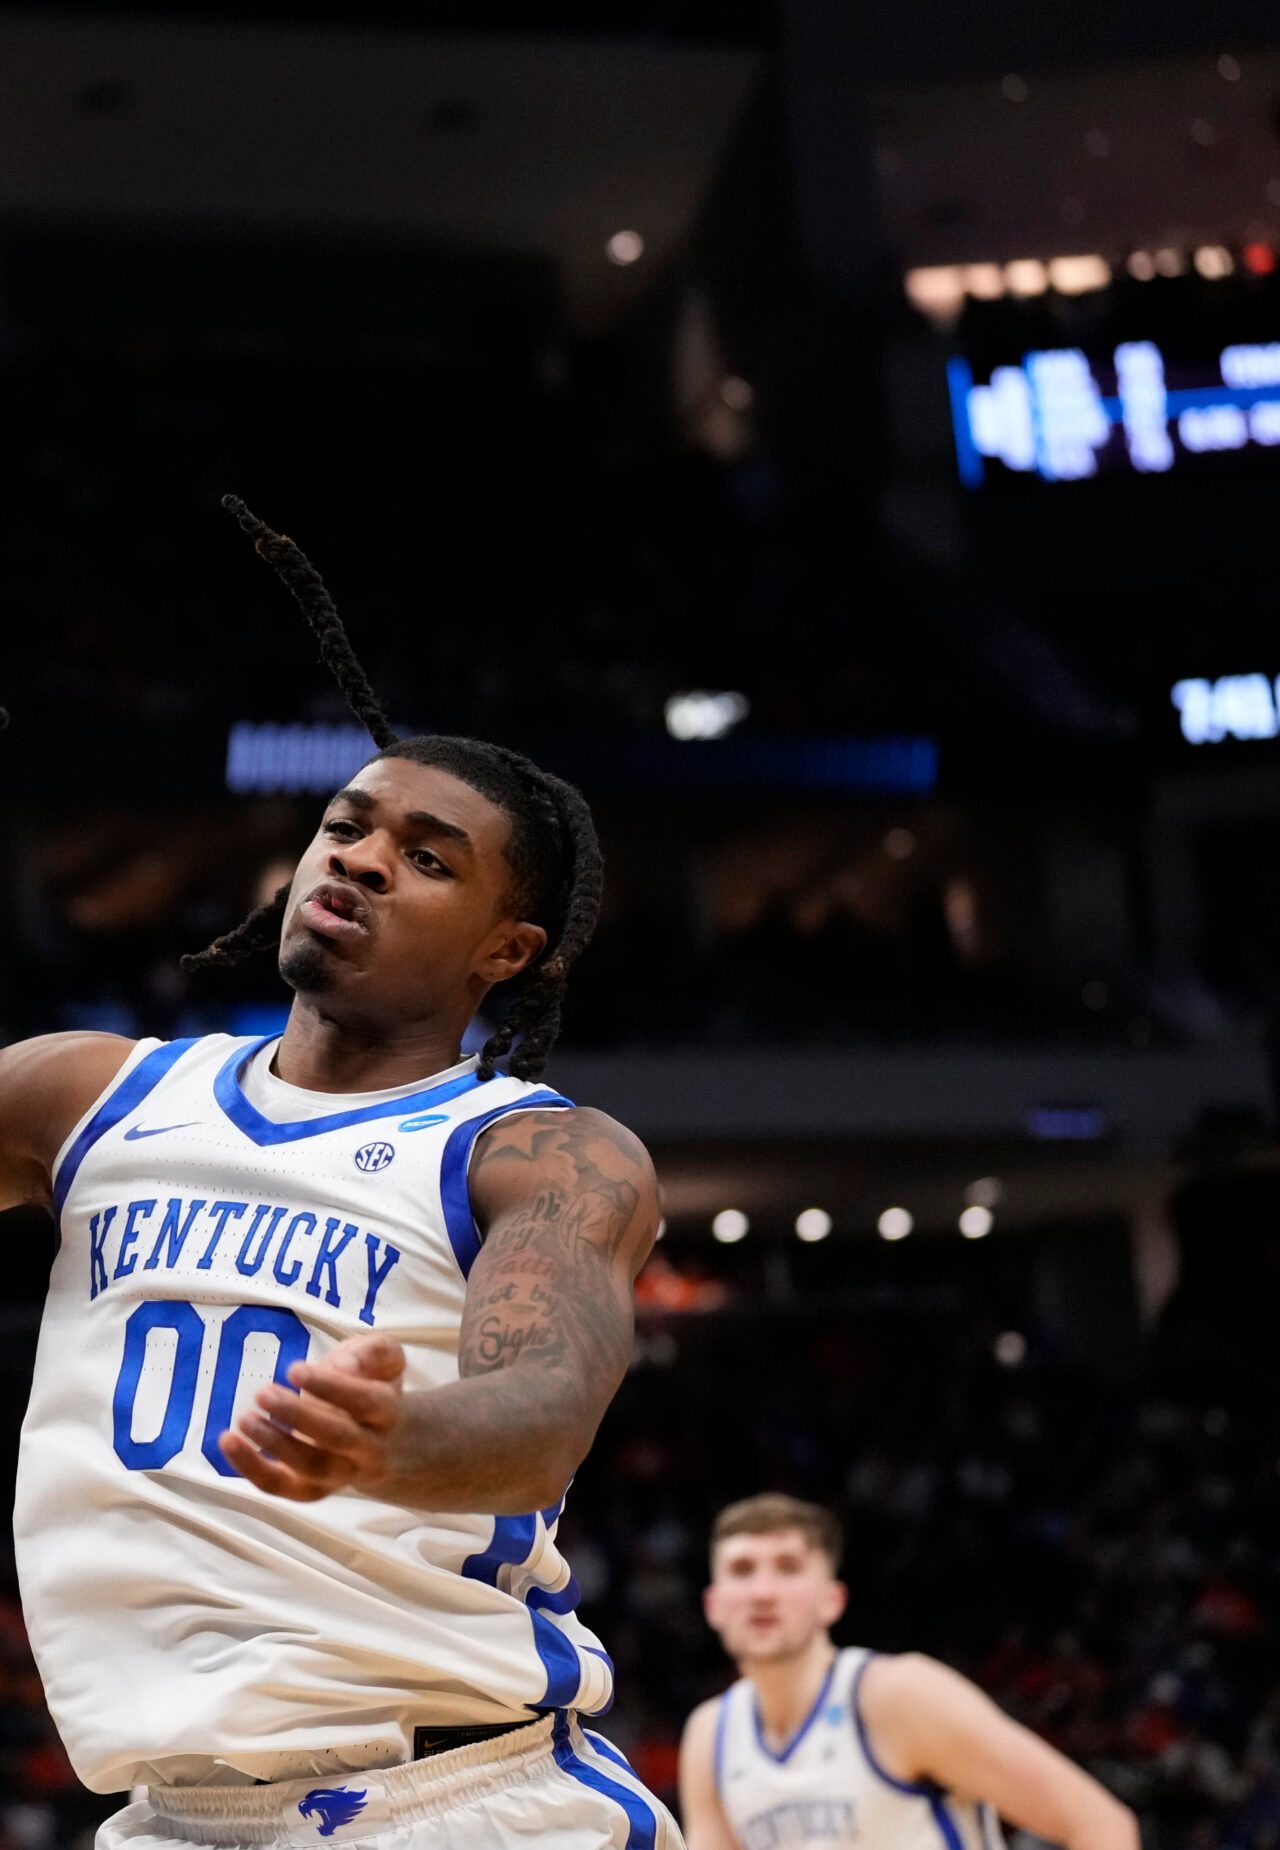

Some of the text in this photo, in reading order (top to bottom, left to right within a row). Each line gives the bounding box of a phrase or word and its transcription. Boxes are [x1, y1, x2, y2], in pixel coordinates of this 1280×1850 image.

[356, 1142, 395, 1172] SEC
[89, 1198, 401, 1327] KENTUCKY
[112, 1300, 311, 1478] 00
